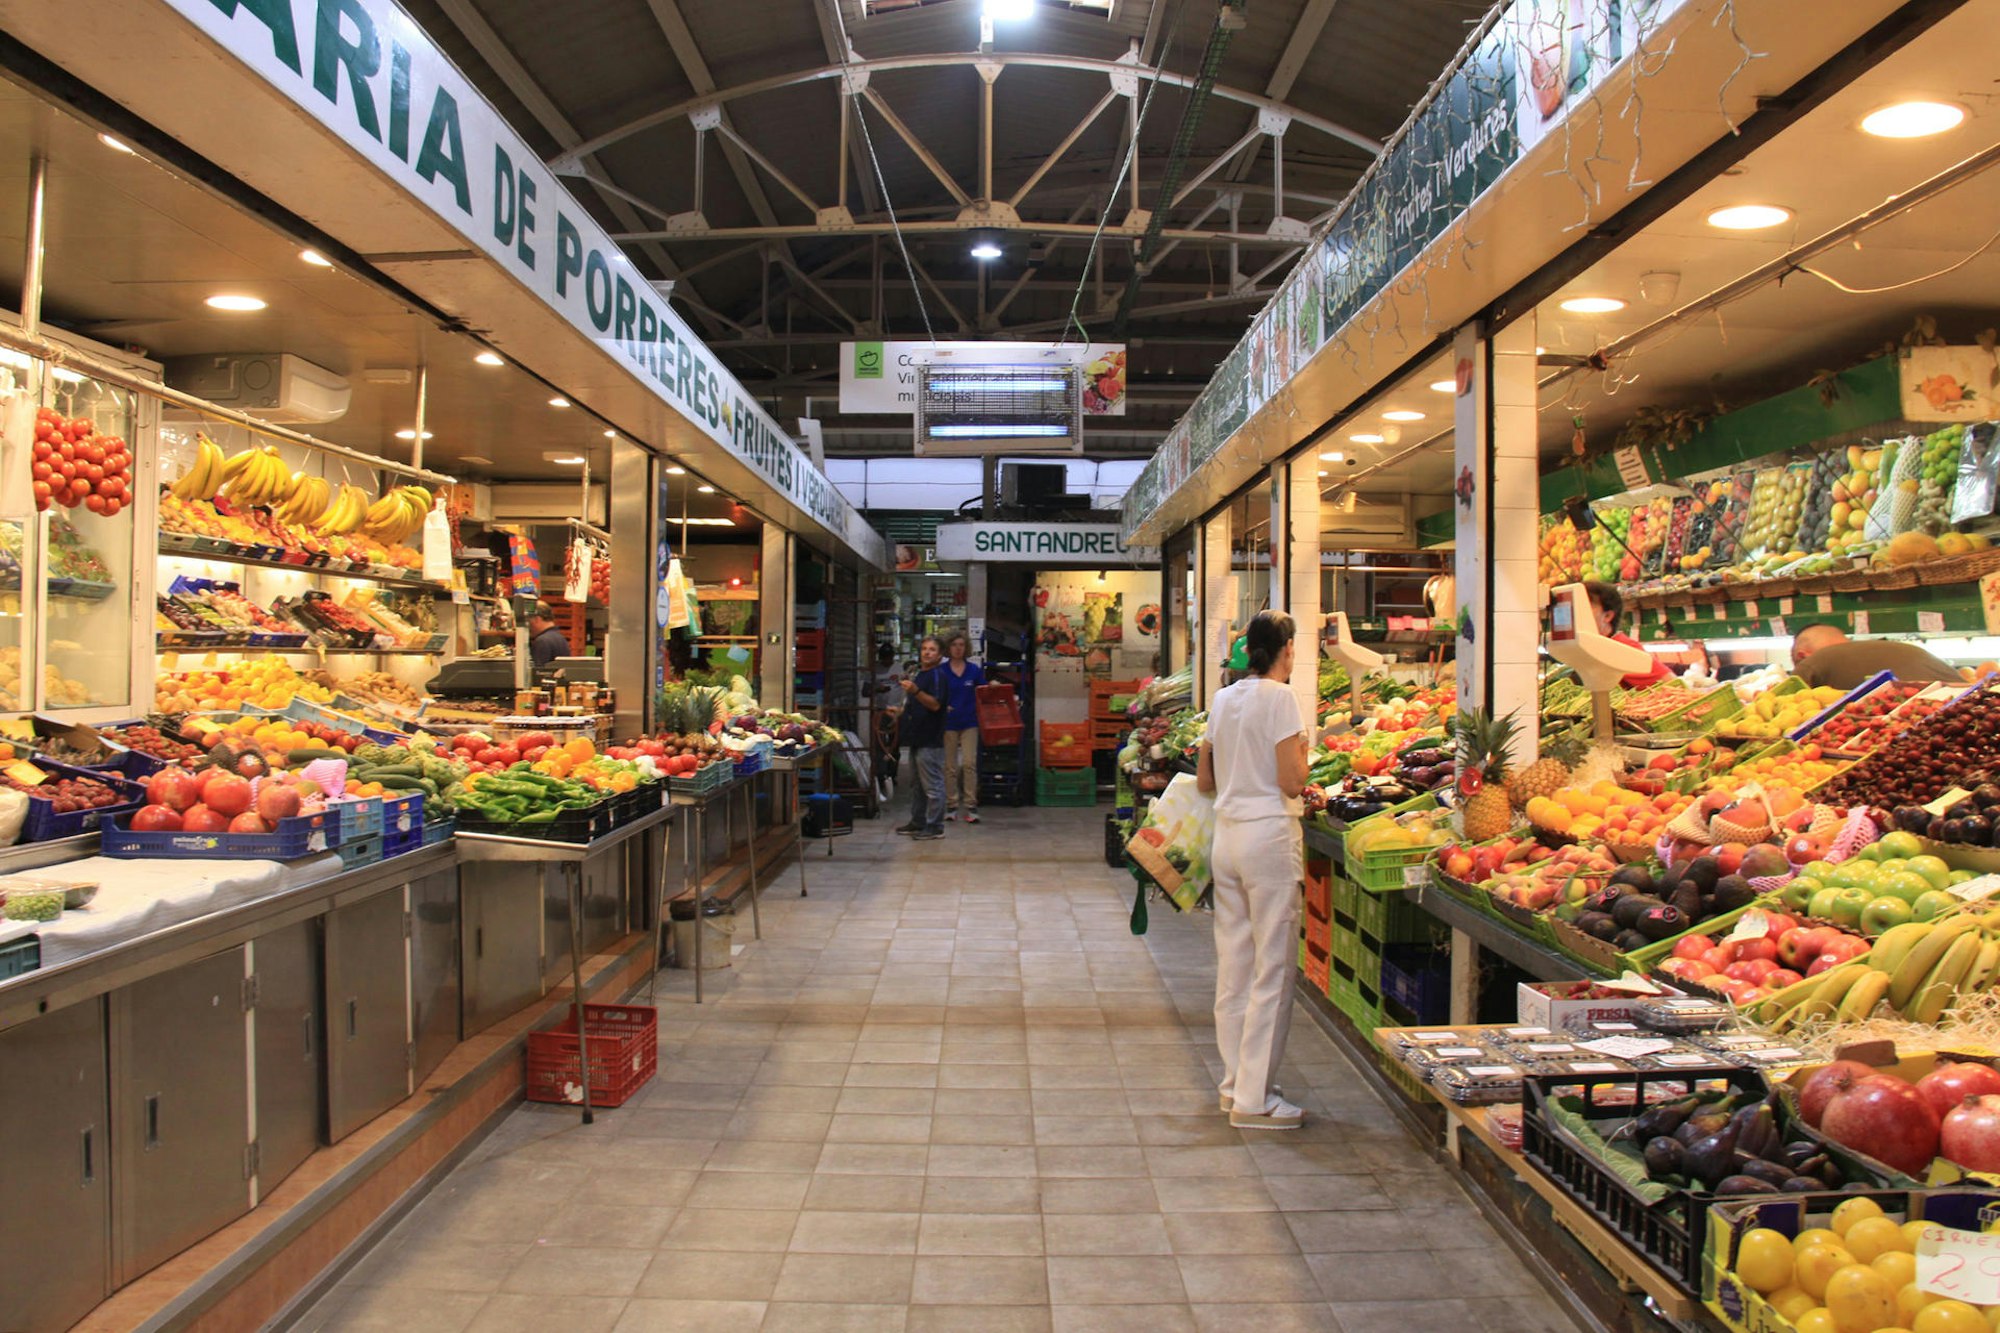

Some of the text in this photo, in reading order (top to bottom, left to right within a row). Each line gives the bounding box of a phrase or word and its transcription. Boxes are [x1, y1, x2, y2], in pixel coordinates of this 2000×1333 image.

[1445, 98, 1508, 187] Verdures
[494, 143, 536, 271] DE
[556, 211, 721, 430] PORRERES
[733, 395, 793, 491] FRUITES
[975, 531, 1130, 553] SANTANDREU
